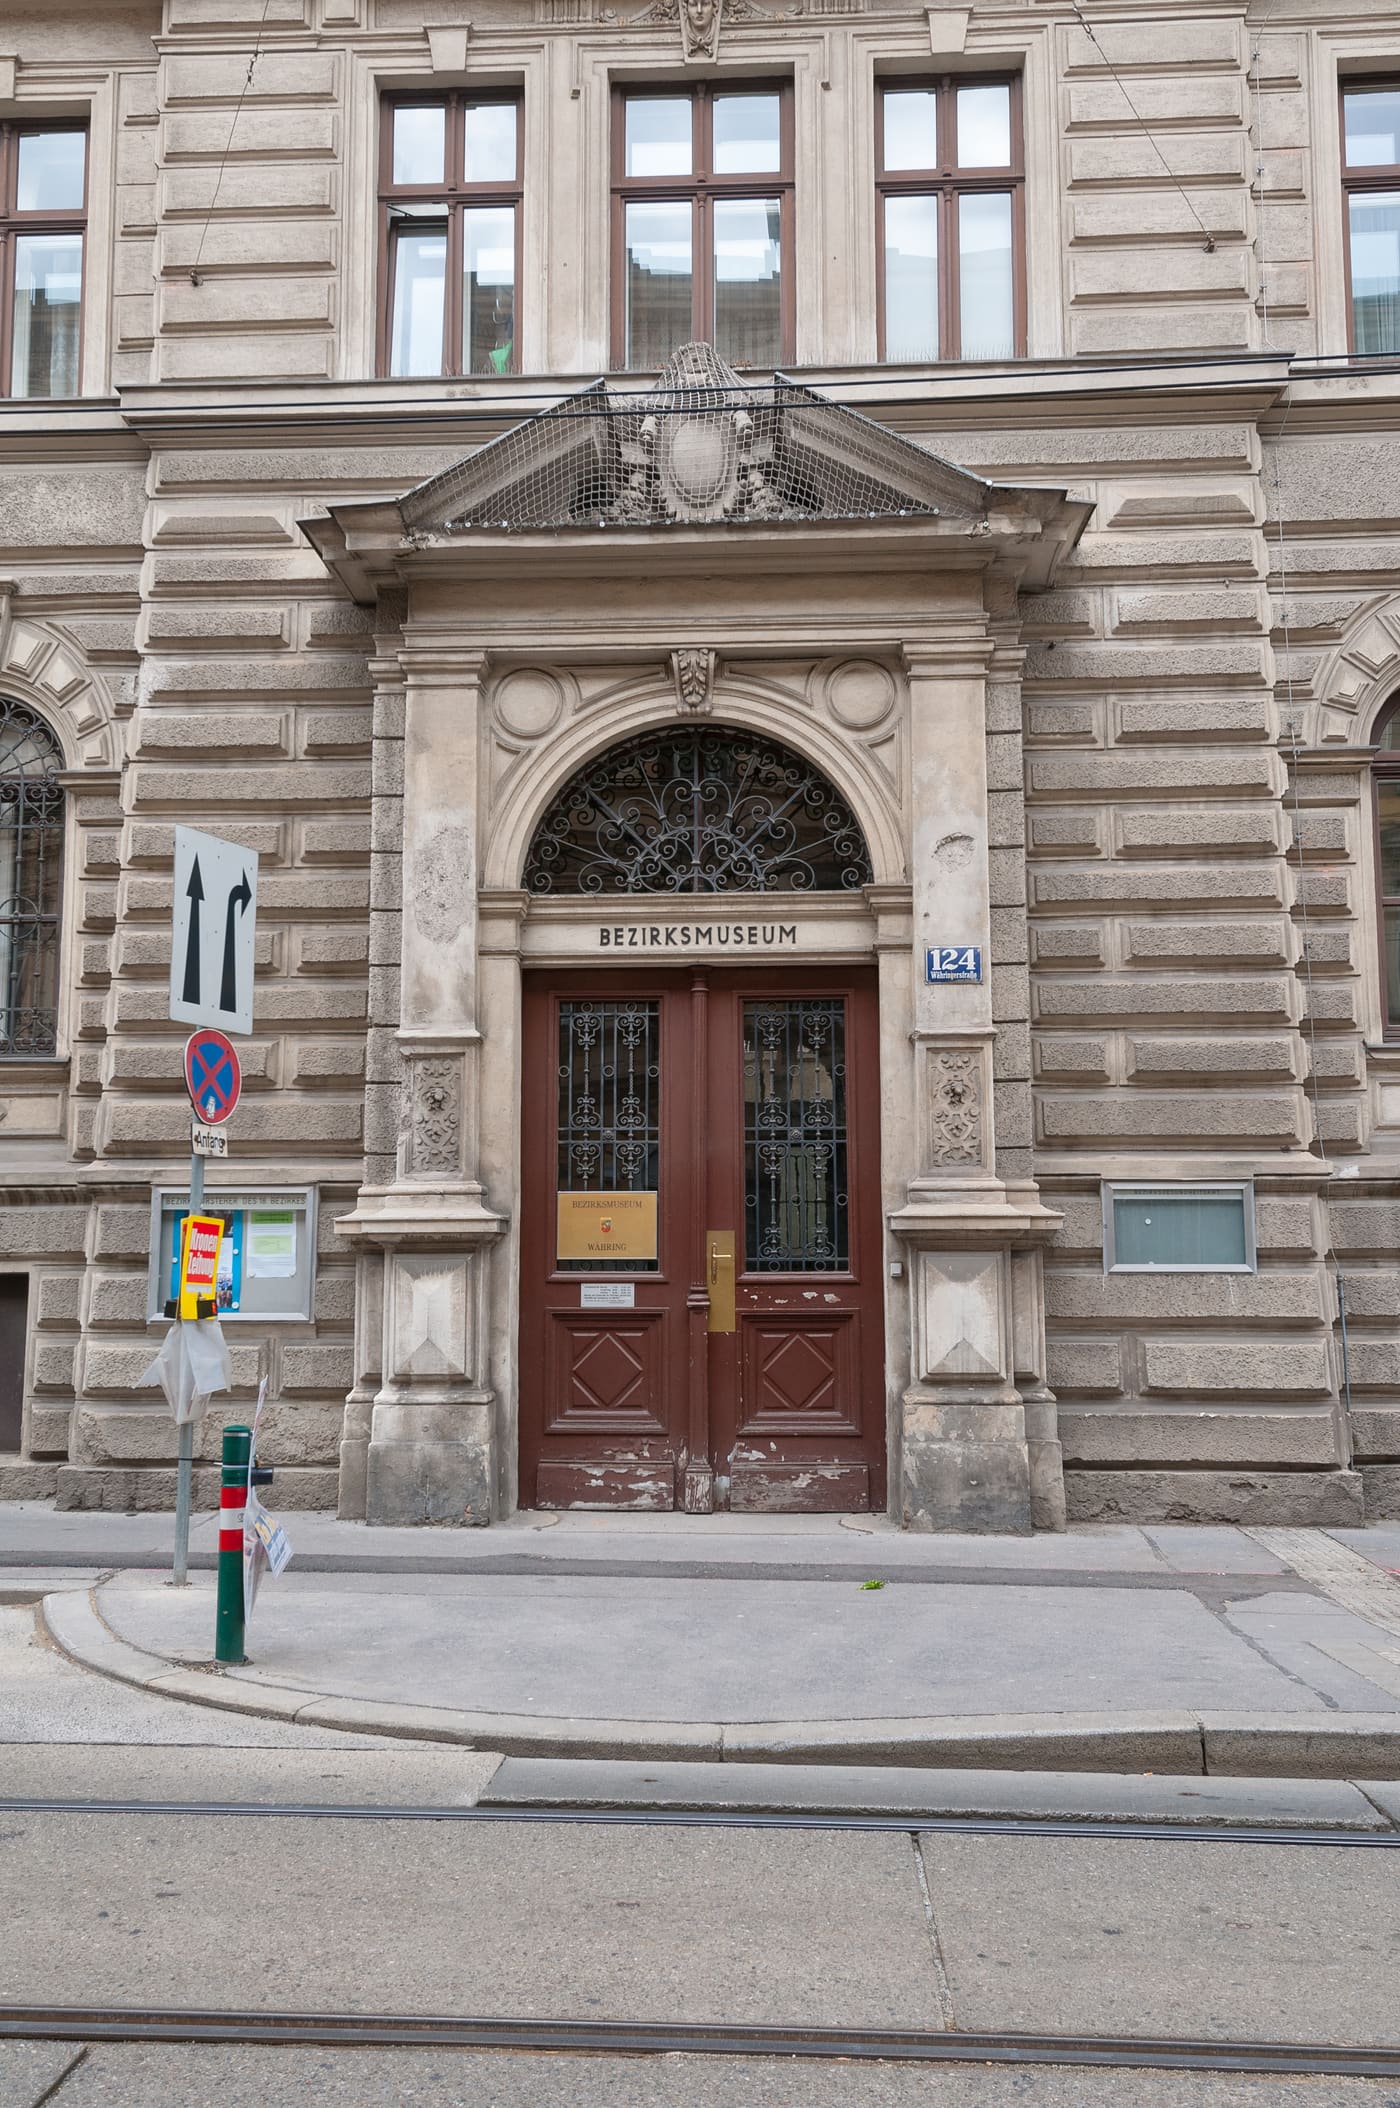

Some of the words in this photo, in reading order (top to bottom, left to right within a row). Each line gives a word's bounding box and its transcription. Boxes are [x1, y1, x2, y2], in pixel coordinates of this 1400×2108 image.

[599, 925, 798, 946] BEZIRKSMUSEUM
[930, 948, 976, 971] 124
[195, 1130, 225, 1153] Anfang
[572, 1199, 643, 1210] BEZIRKSMUSEUM
[189, 1228, 219, 1252] Kronen
[187, 1251, 215, 1279] Zeitung
